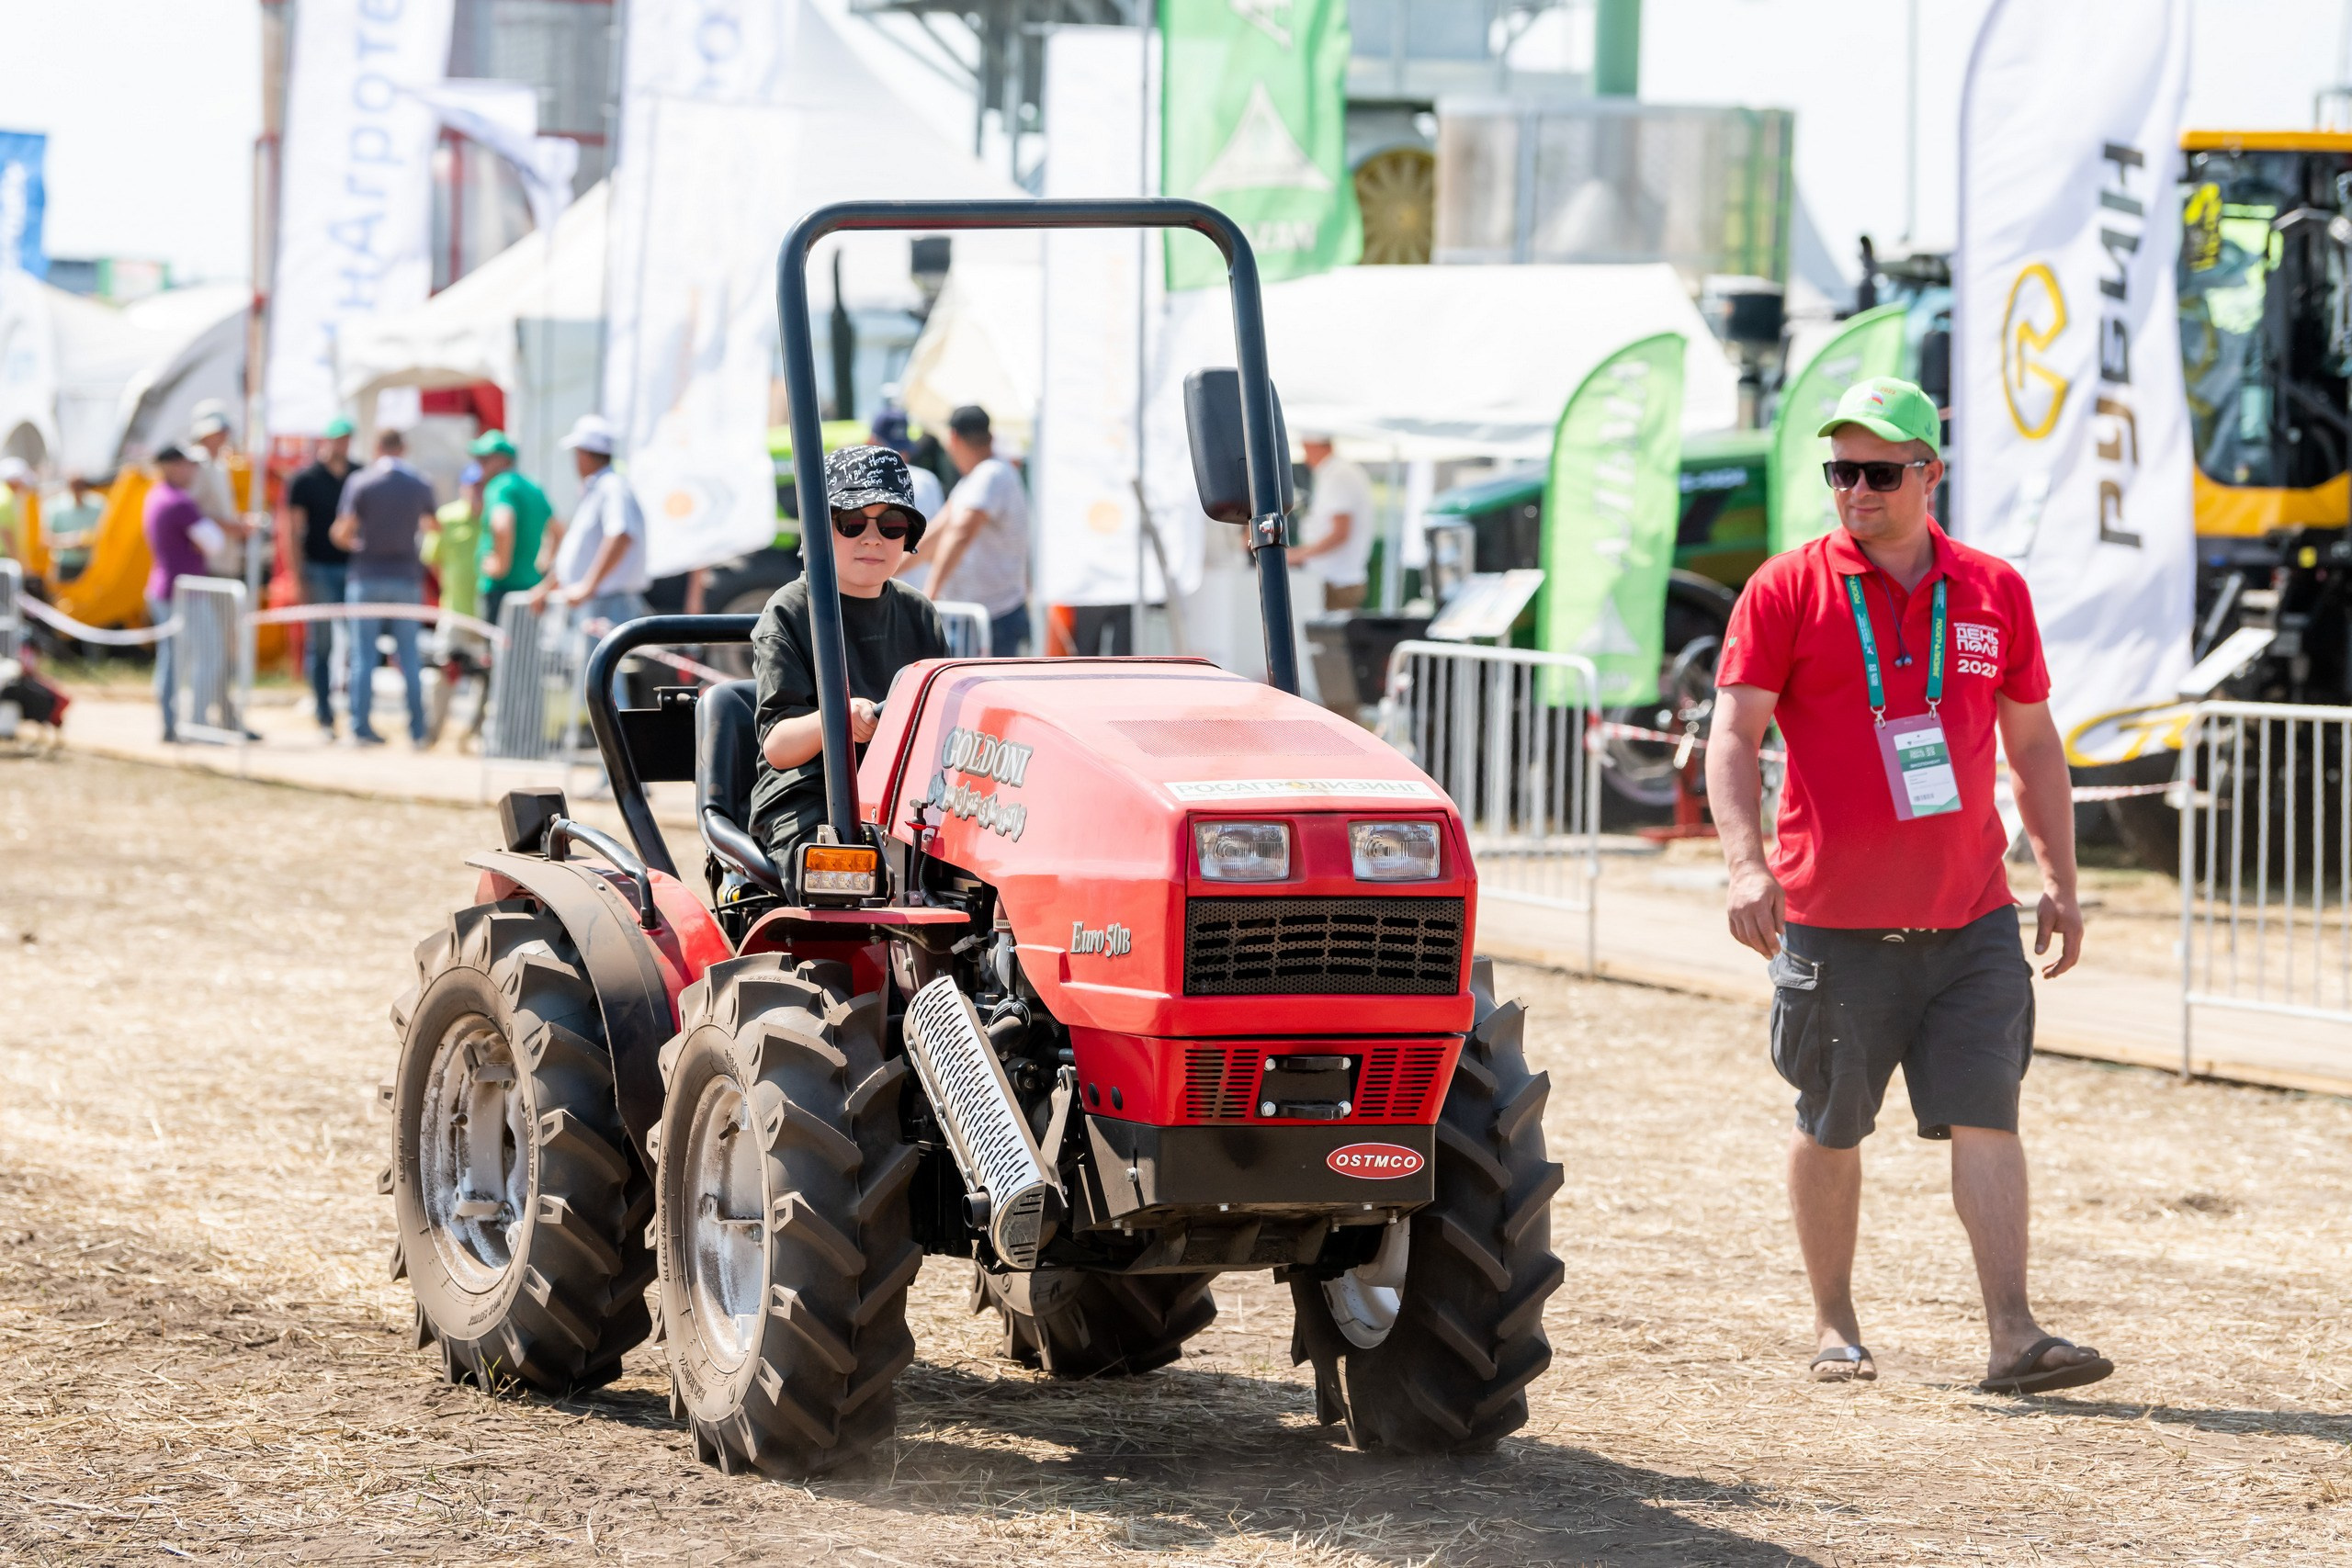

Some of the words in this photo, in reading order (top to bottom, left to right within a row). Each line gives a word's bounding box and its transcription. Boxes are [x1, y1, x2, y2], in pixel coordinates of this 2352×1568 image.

[2095, 142, 2145, 549] РУБИН
[862, 476, 883, 489] Tokyo
[1956, 627, 1999, 646] ДЕНЬ
[1956, 638, 1998, 660] ПОЛЯ
[1957, 659, 1998, 678] 2023
[942, 727, 1033, 787] GOLDONI
[1070, 920, 1104, 953] Euro
[1336, 1154, 1417, 1168] OSTMCO
